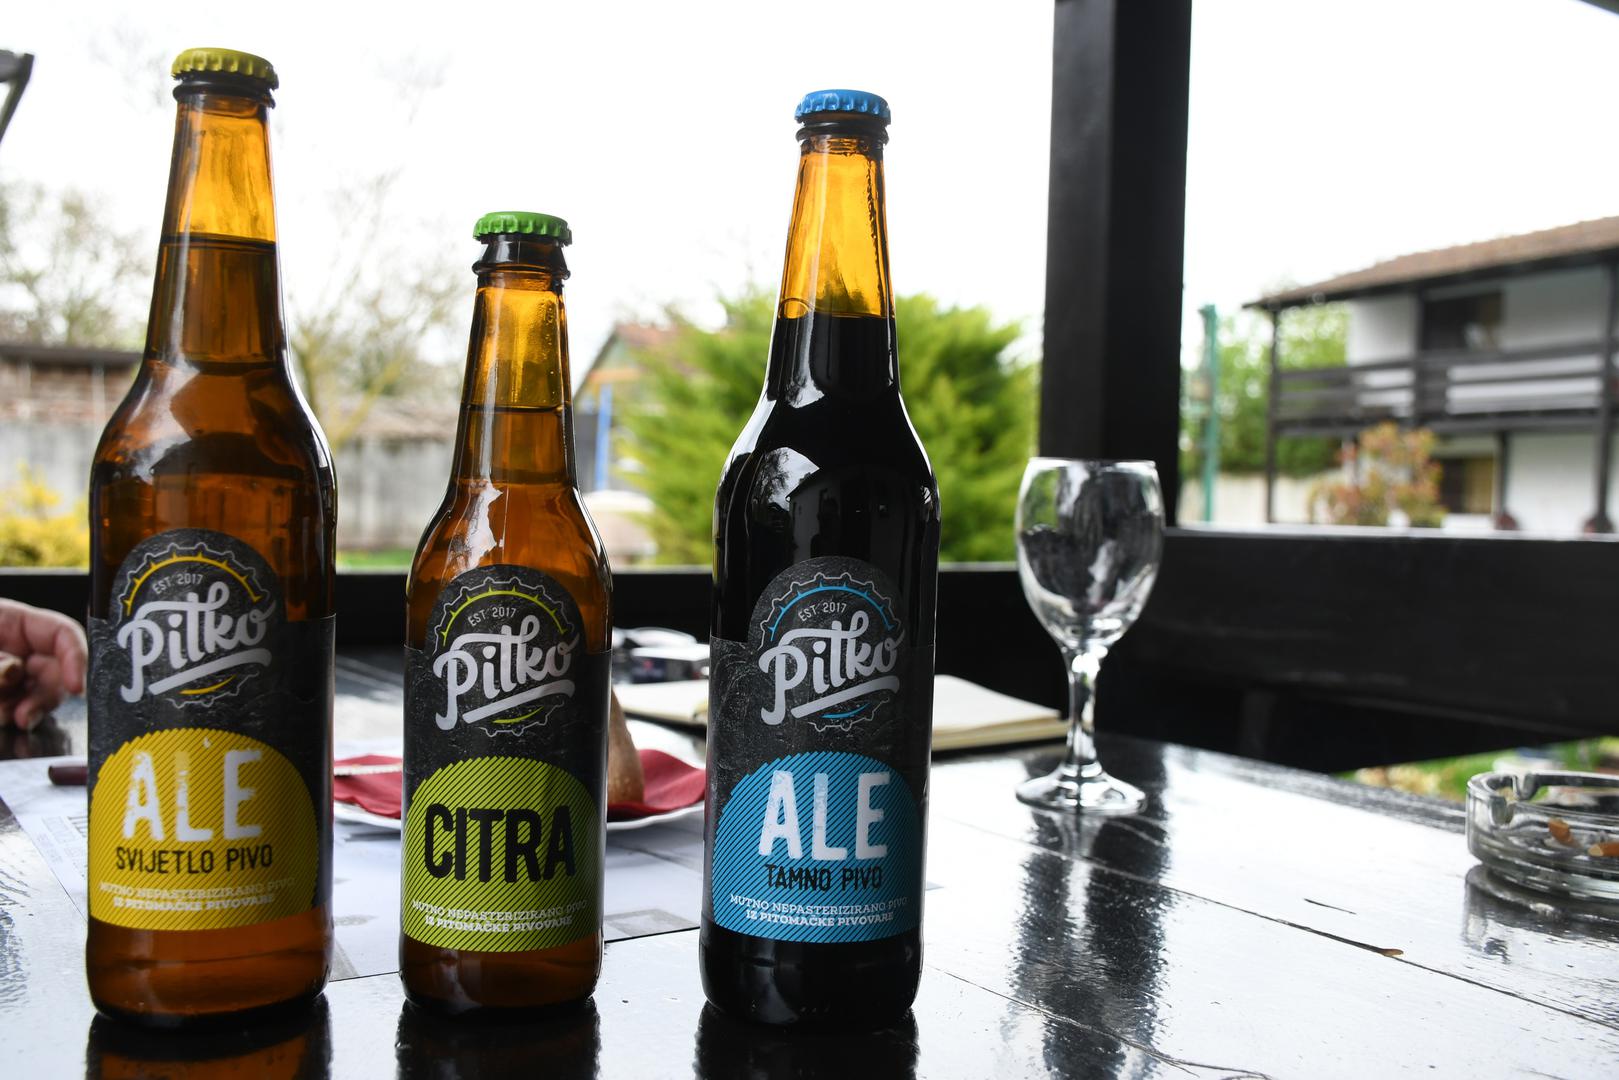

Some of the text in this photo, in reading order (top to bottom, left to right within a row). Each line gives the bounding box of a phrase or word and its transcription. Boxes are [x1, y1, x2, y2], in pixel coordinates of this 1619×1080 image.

[176, 573, 204, 585] 2017
[492, 606, 517, 618] 2017
[823, 602, 847, 613] 2017
[117, 581, 276, 703] Pitko
[433, 615, 580, 731] Pitko
[758, 610, 905, 725] Pitko
[123, 749, 263, 842] ALE
[758, 770, 890, 861] ALE
[424, 803, 576, 883] CITRA
[116, 846, 214, 875] SVIJETLO
[226, 844, 273, 872] PIVO
[765, 864, 883, 891] TAMNO PIVO
[412, 900, 444, 916] MUTNO
[448, 906, 563, 921] NEPASTERIZIRANO
[730, 894, 770, 911] MUTNO
[771, 902, 886, 916] NEPASTERIZIRANO
[746, 910, 894, 927] IZ PITOMAČKE PIVOVARE
[437, 917, 510, 933] PITOMAČKE
[512, 914, 573, 932] PIVOVARE
